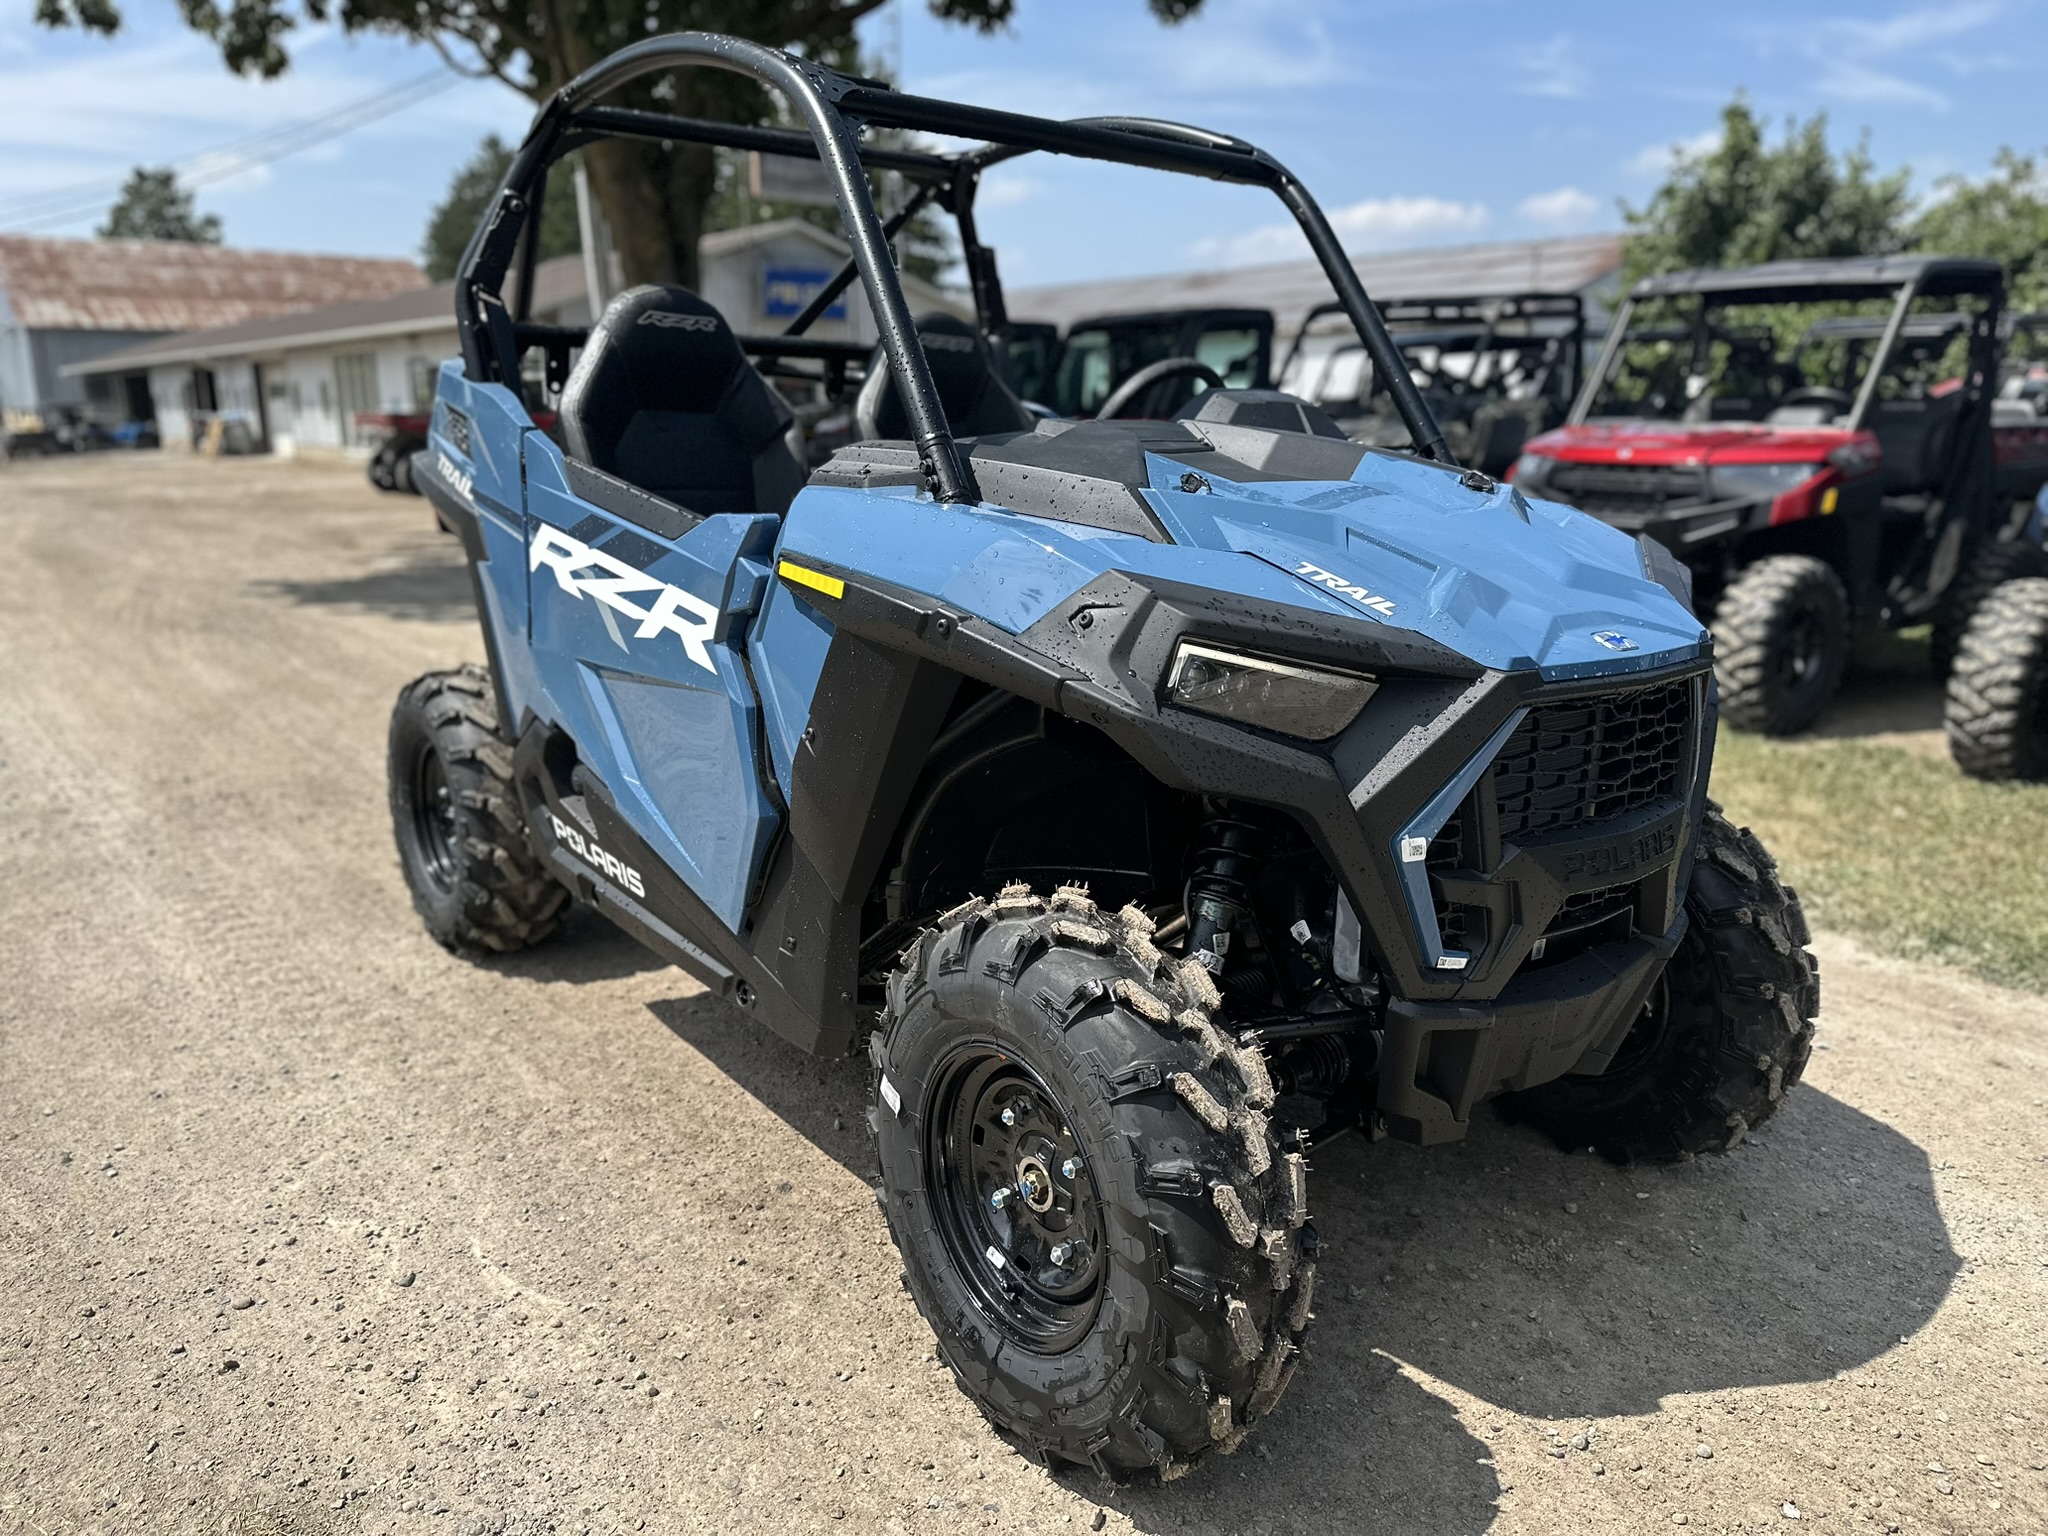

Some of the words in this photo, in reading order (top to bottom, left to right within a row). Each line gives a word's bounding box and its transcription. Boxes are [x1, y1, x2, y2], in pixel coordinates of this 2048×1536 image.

[637, 310, 718, 332] RZR
[437, 450, 474, 501] TRAIL
[530, 522, 720, 676] RZR
[1295, 561, 1397, 616] TRAIL
[551, 814, 645, 898] POLARIS
[1560, 823, 1675, 882] POLARIS
